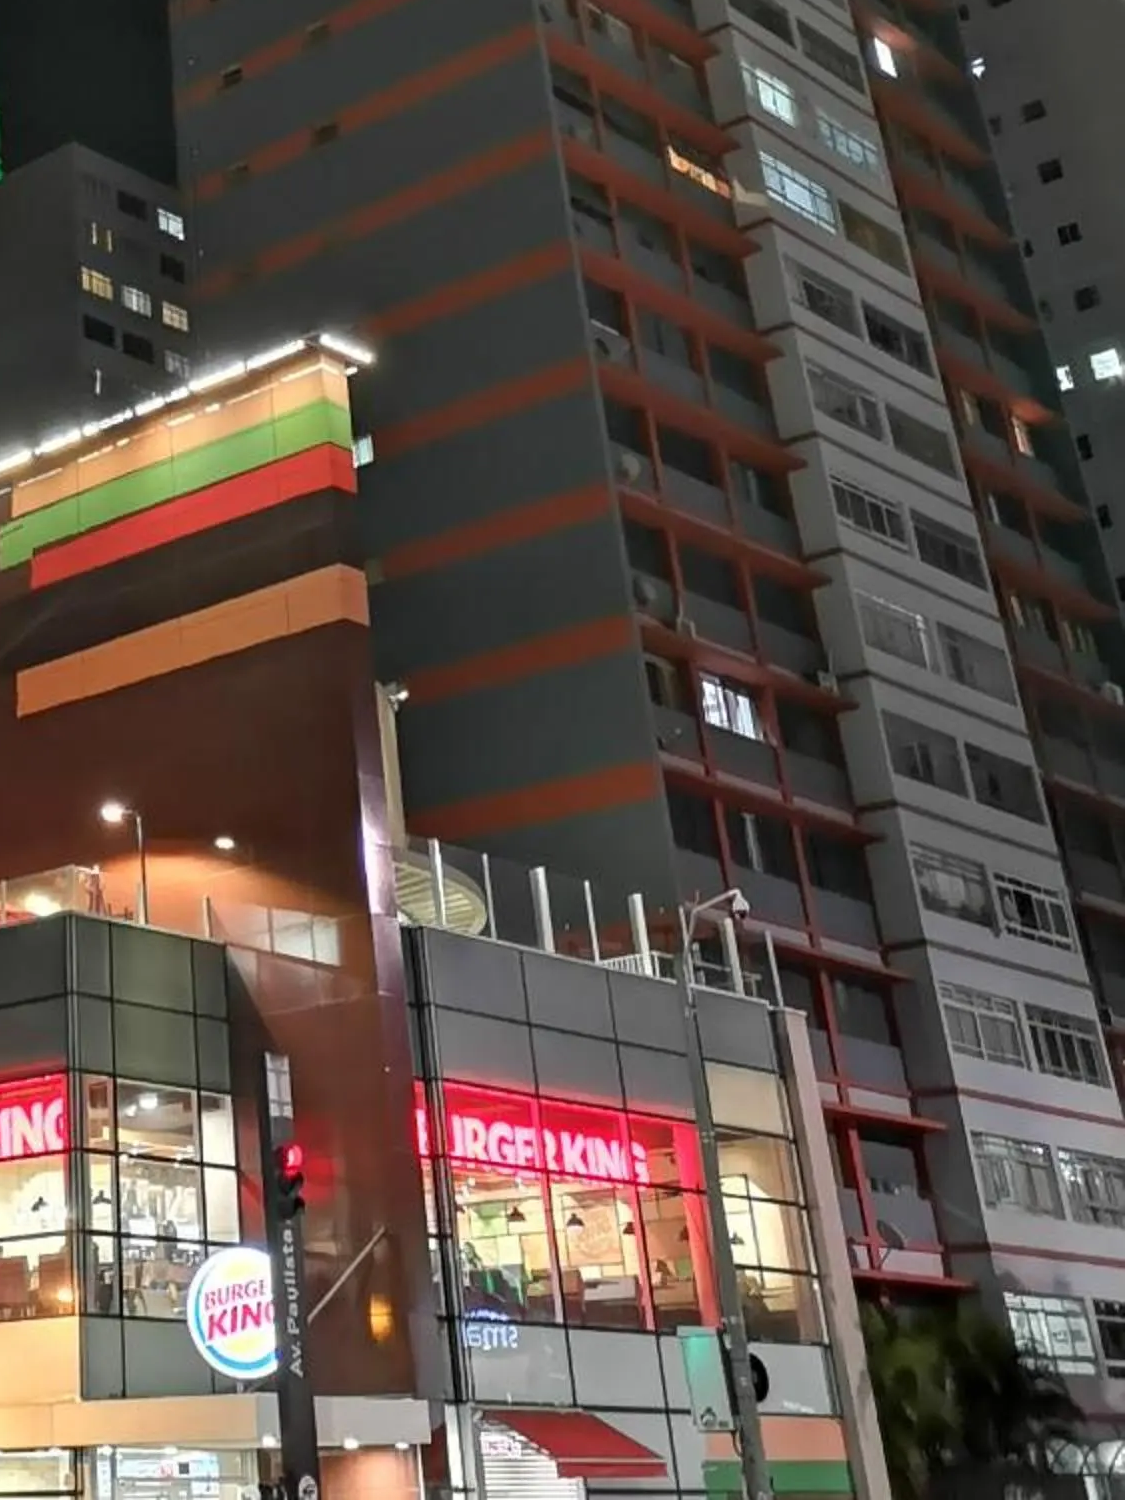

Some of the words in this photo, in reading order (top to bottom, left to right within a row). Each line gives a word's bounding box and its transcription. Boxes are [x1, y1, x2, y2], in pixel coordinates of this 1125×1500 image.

[204, 1279, 267, 1311] BURGE
[283, 1228, 300, 1335] Paulista
[290, 1341, 304, 1379] Av.
